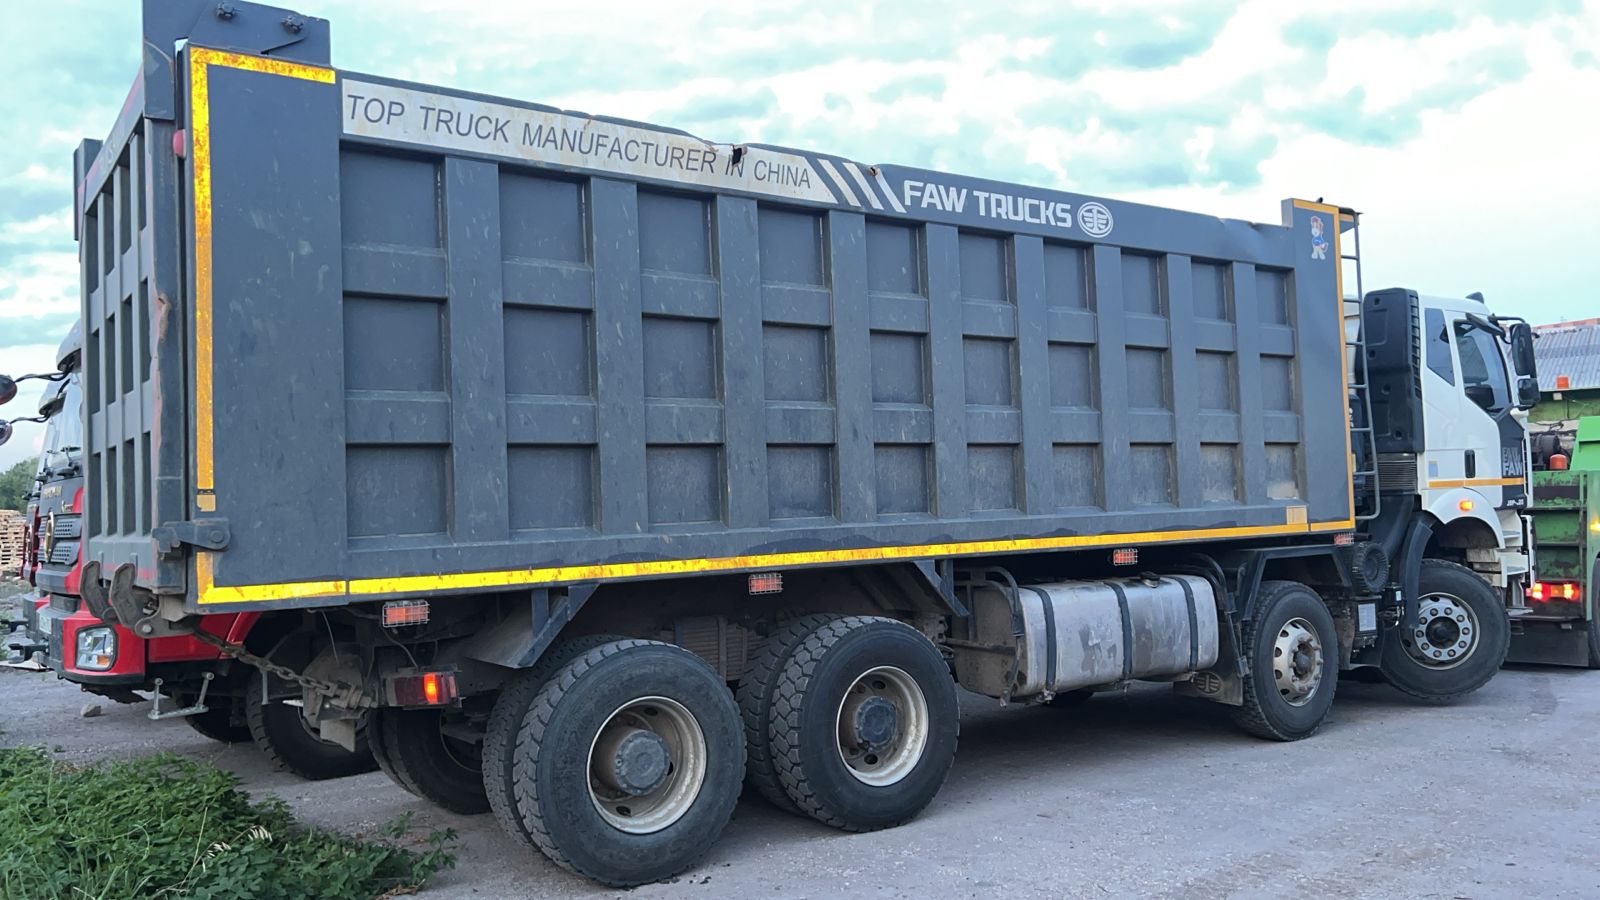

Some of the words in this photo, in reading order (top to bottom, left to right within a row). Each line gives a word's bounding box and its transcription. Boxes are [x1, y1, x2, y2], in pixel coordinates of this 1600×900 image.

[347, 95, 405, 126] TOP
[419, 105, 511, 143] TRUCK
[522, 122, 717, 174] MANUFACTURER
[754, 160, 811, 189] CHINA
[904, 180, 967, 213] FAW
[973, 190, 1073, 228] TRUCKS
